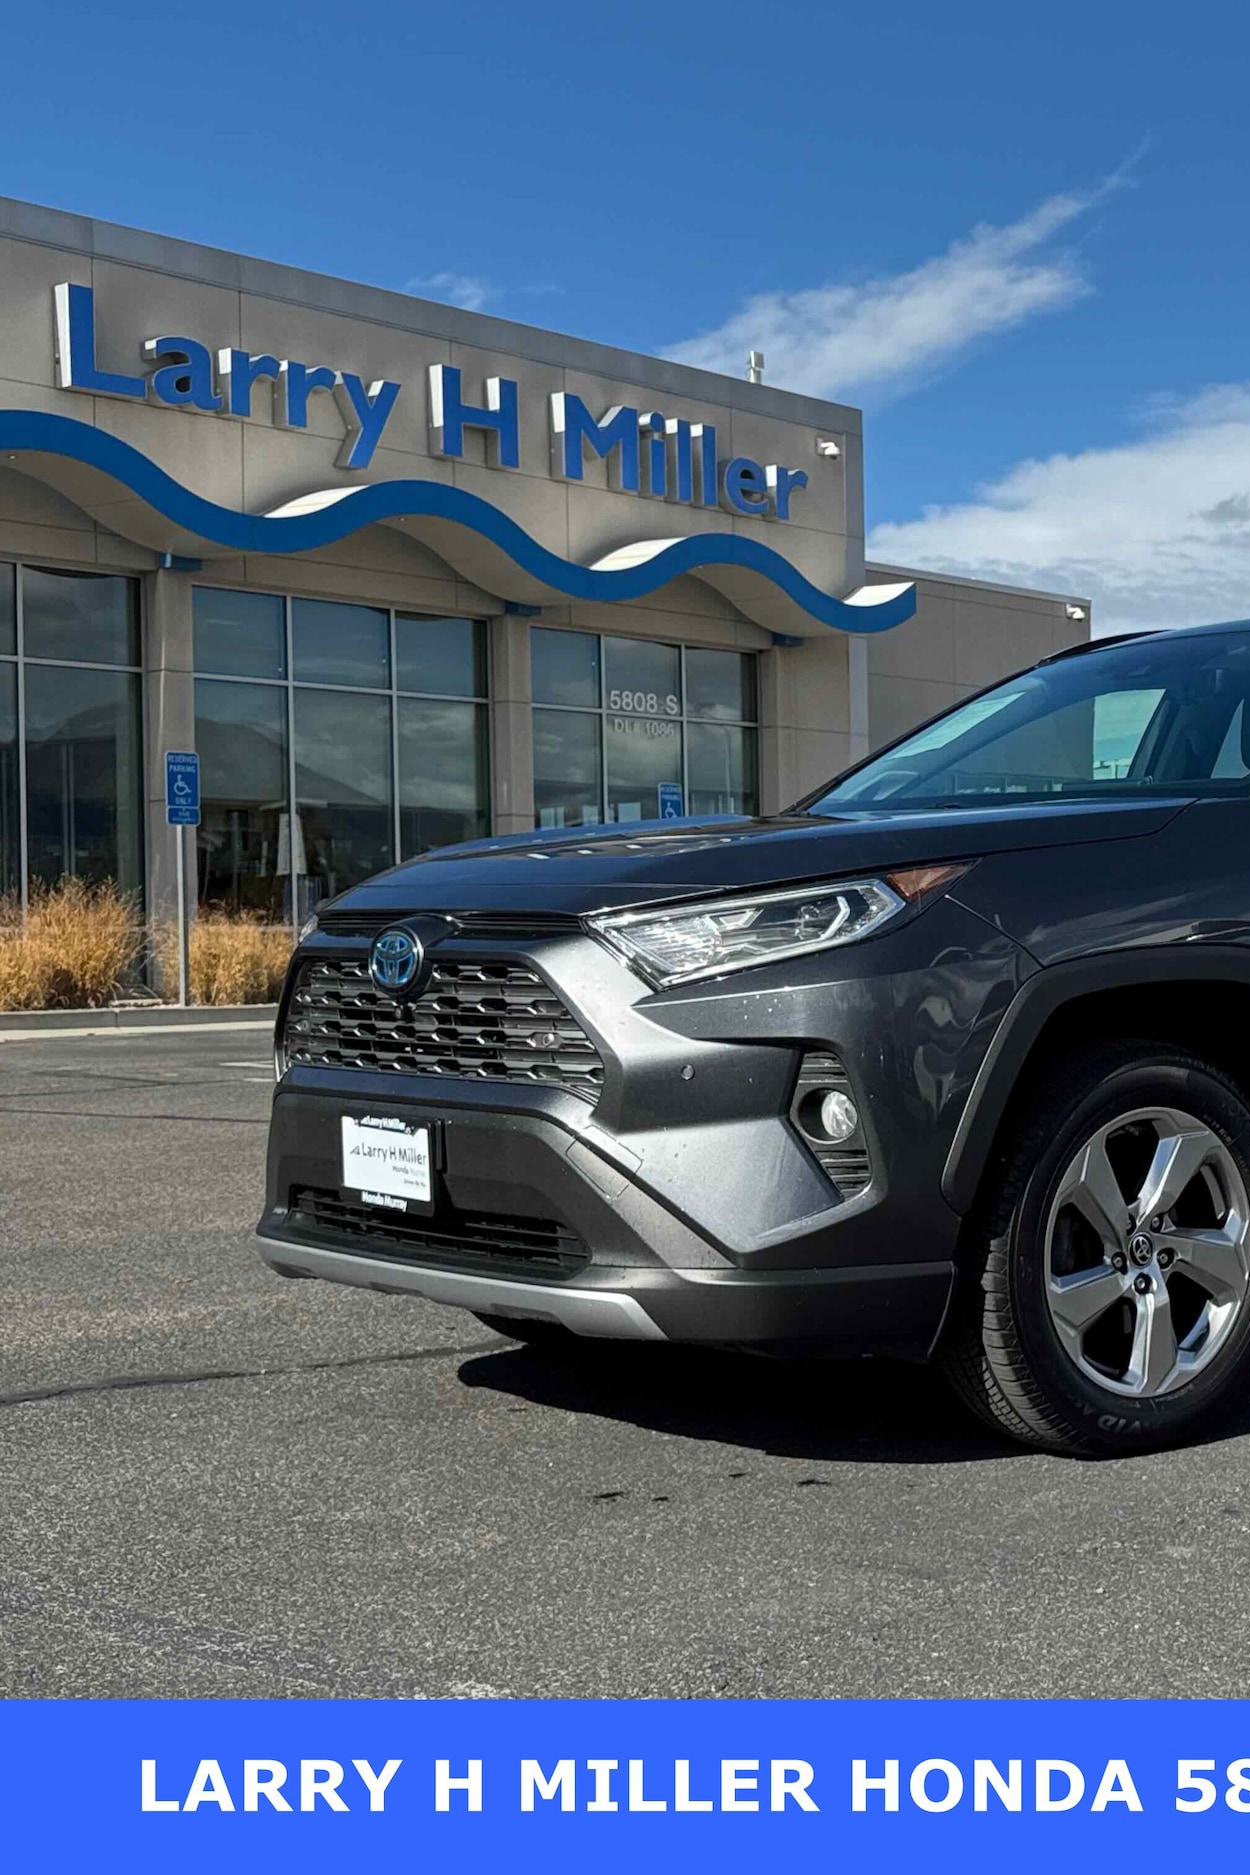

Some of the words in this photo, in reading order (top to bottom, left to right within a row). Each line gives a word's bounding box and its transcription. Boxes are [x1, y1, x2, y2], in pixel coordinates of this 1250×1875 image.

[55, 282, 402, 468] Larry
[429, 363, 519, 467] H
[552, 392, 808, 520] Miller
[610, 690, 657, 713] 5808
[665, 694, 678, 714] S
[169, 764, 196, 773] PARKING
[362, 1142, 387, 1162] Larry
[389, 1146, 397, 1160] H
[399, 1147, 427, 1166] Miller
[362, 1191, 384, 1206] Honda
[384, 1195, 407, 1212] Murray
